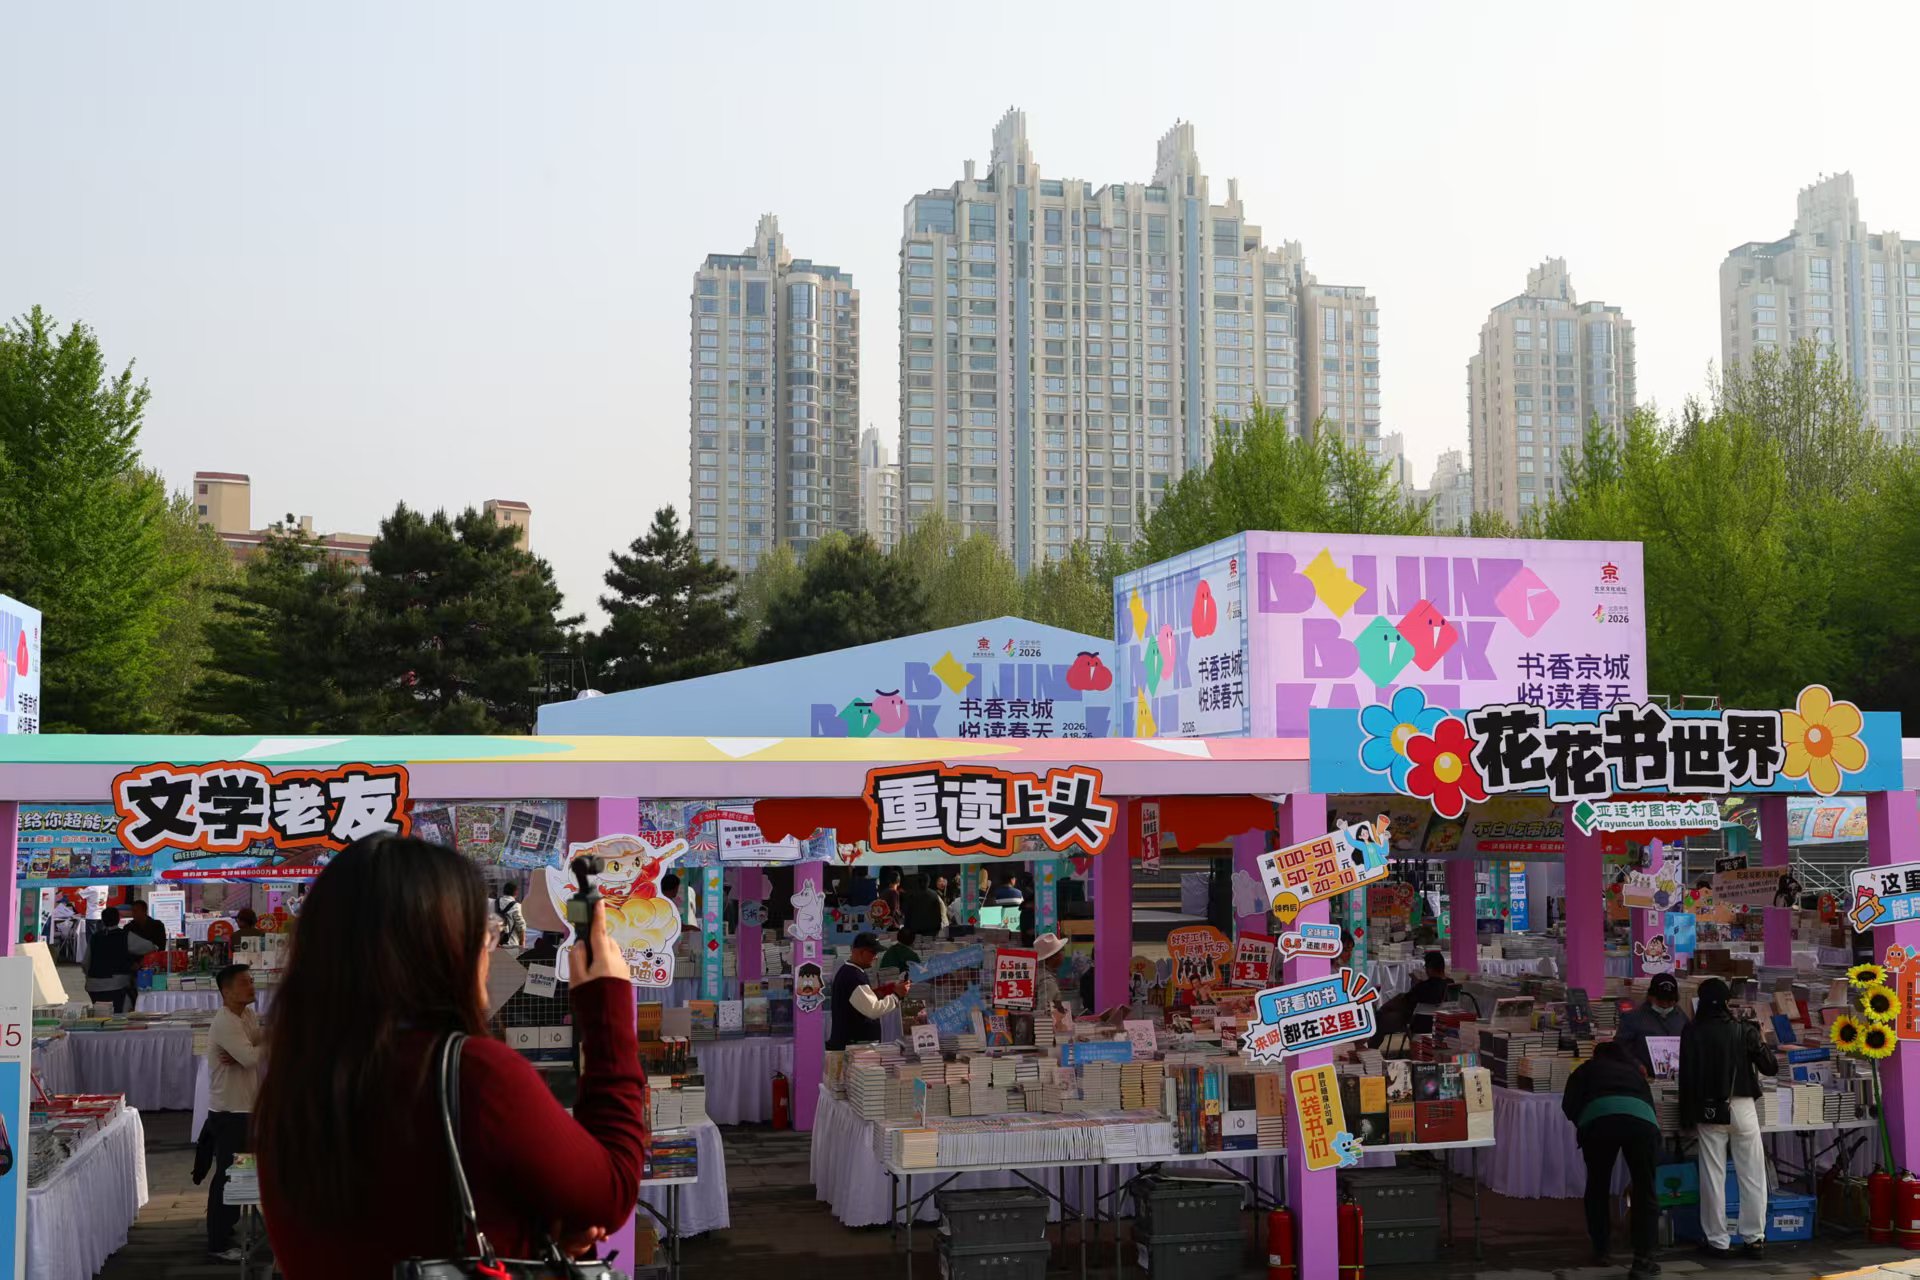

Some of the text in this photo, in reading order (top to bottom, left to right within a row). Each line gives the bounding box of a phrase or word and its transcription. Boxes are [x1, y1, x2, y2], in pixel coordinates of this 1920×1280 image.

[1607, 614, 1630, 624] 2026
[1018, 648, 1042, 658] 2026
[1198, 650, 1243, 682] 书香京城
[1517, 652, 1631, 681] 书香京城
[959, 697, 1054, 720] 书香京城
[1198, 681, 1244, 712] 悦读春天
[1517, 682, 1631, 710] 悦读春天
[959, 721, 1054, 738] 悦读春天
[1062, 722, 1088, 731] 2026.
[1472, 709, 1781, 797] 花花书世界
[126, 772, 401, 844] 文学老友
[876, 771, 1111, 847] 重读上头
[1597, 803, 1719, 818] 亚运村图书大厦
[1597, 817, 1719, 829] Yayuncun Books Building
[1274, 902, 1298, 913] 领券后
[1307, 927, 1336, 938] 全场图书
[1275, 986, 1337, 1015] 好看的书
[1253, 1026, 1281, 1051] 来呀
[1283, 1006, 1365, 1045] 都在这里！
[1297, 1073, 1330, 1160] 口袋书们
